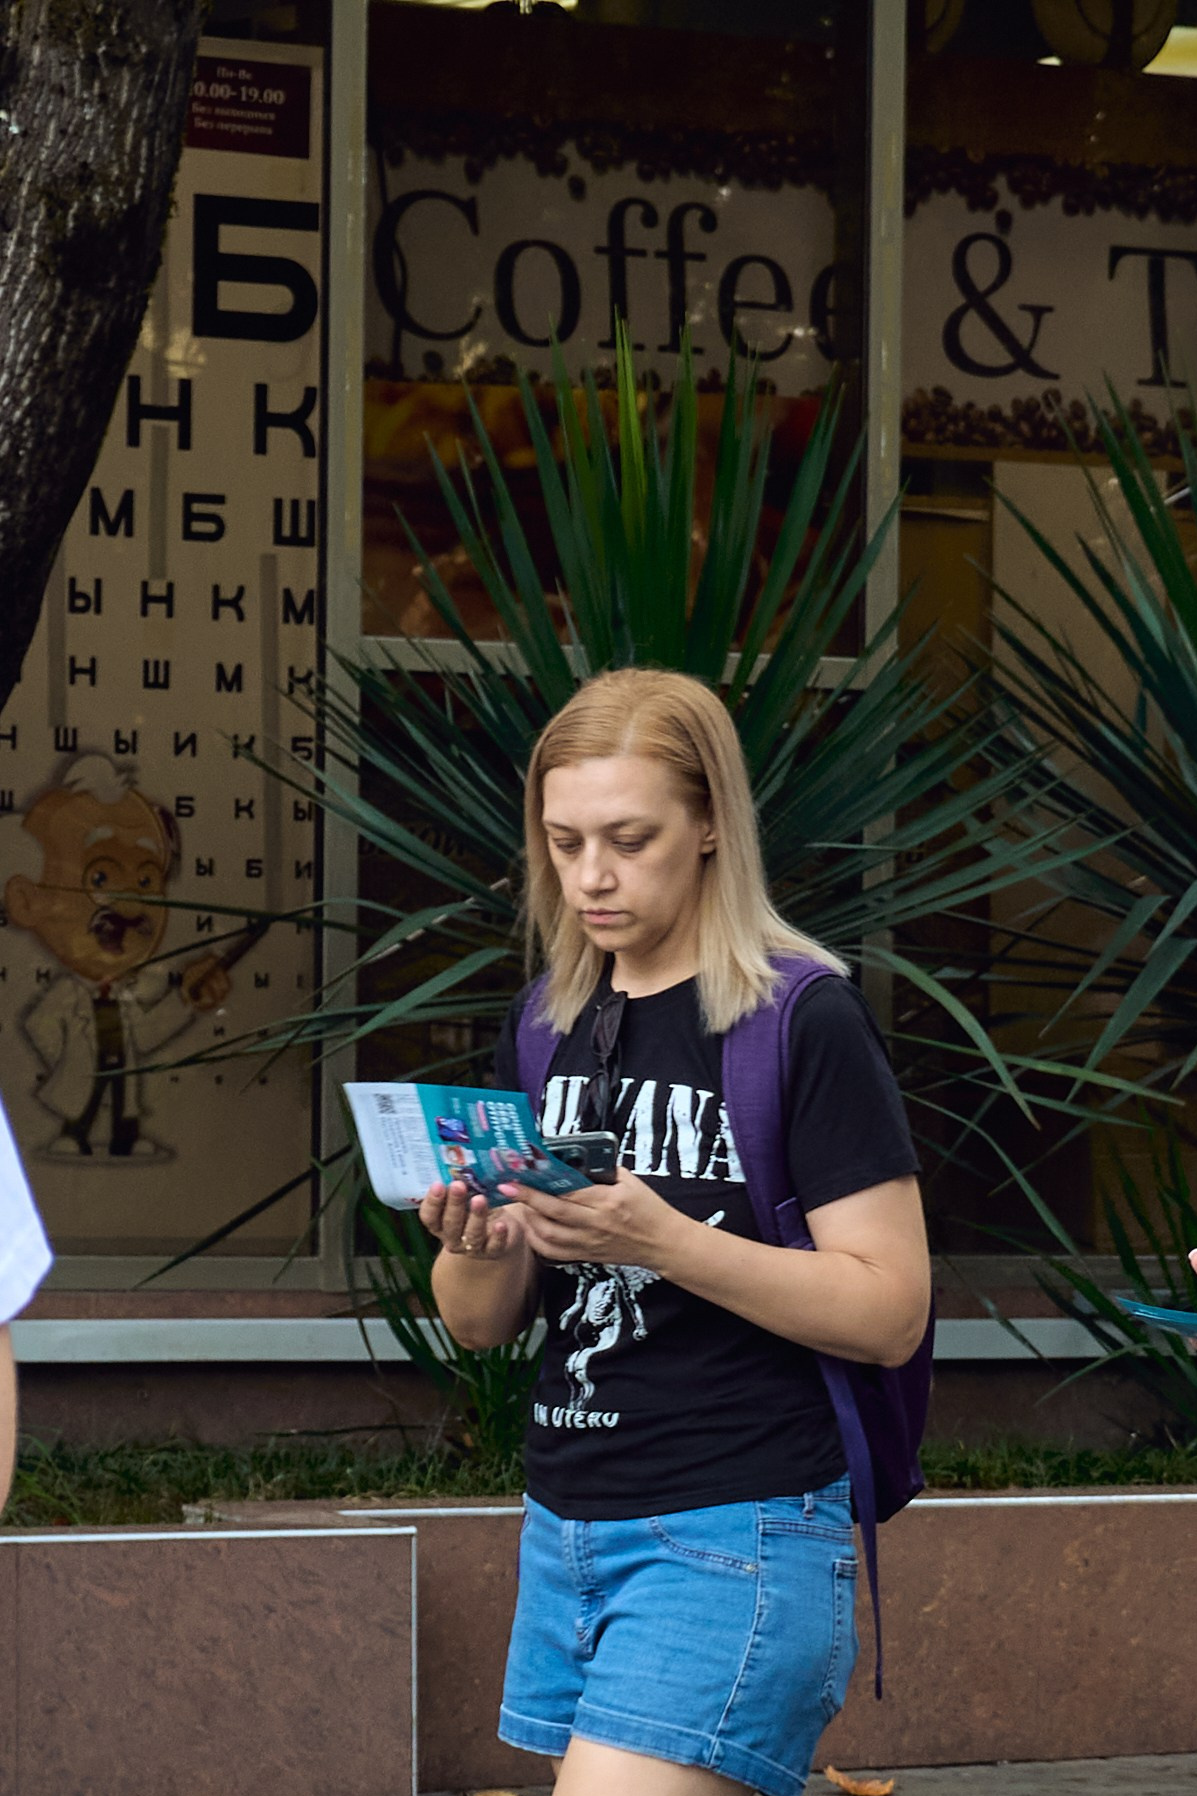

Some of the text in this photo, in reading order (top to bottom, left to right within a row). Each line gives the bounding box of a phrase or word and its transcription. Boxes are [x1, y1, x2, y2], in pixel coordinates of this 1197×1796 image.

[190, 81, 286, 105] 0.00-19.00
[192, 193, 320, 343] Б
[942, 232, 1060, 380] &
[126, 374, 318, 459] Н К
[89, 487, 317, 549] М Б Ш
[68, 576, 316, 625] Ы Н К М
[68, 655, 97, 688] Н
[142, 659, 171, 691] Ш
[215, 661, 243, 694] М
[54, 725, 78, 752] Ш
[113, 728, 138, 755] Ы
[173, 731, 198, 758] И
[291, 736, 314, 761] Б
[175, 796, 195, 818] Б
[234, 797, 255, 820] К
[536, 1075, 747, 1184] IANA
